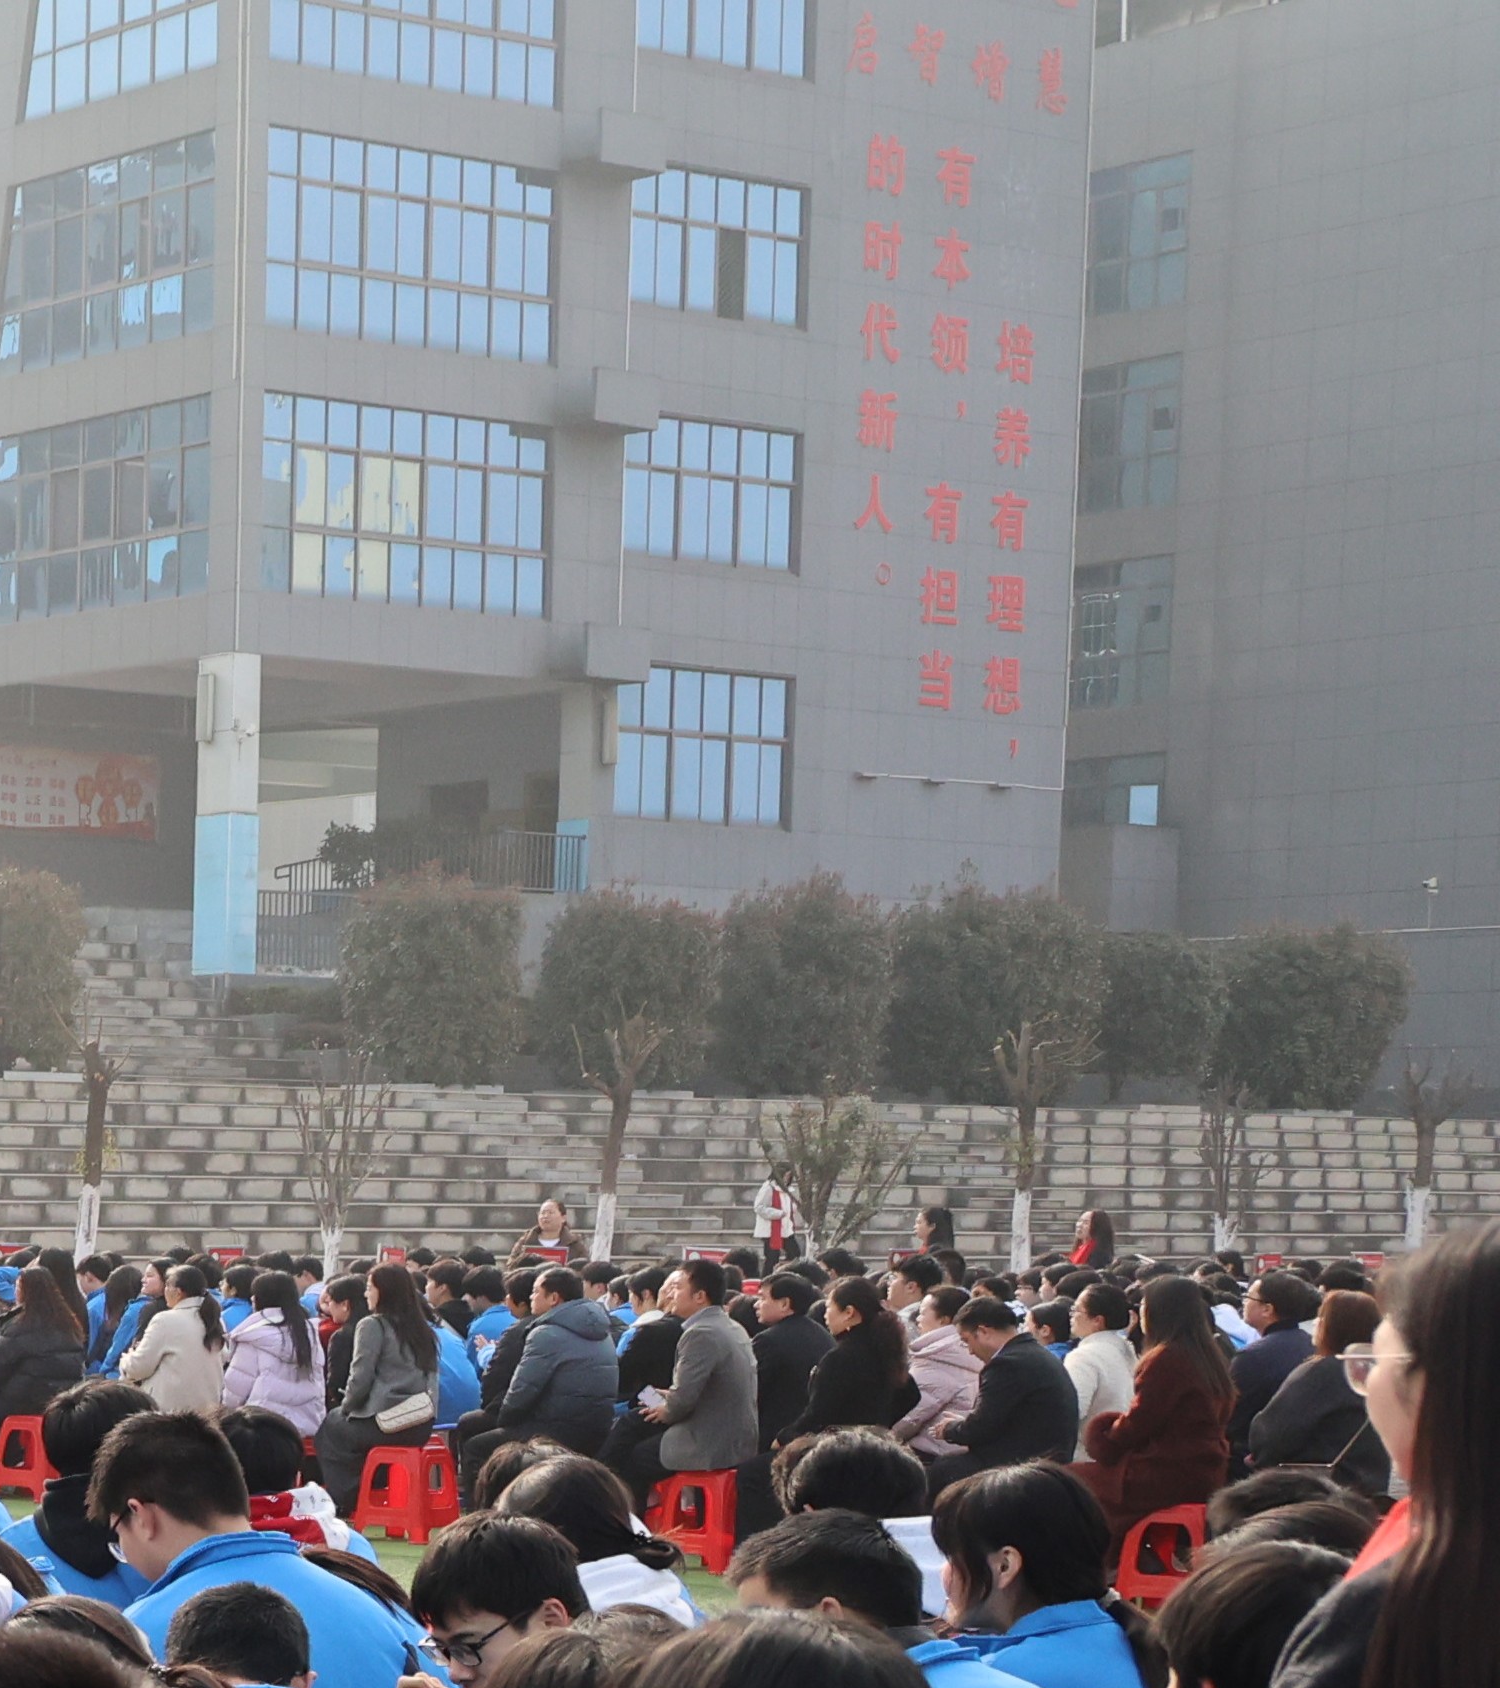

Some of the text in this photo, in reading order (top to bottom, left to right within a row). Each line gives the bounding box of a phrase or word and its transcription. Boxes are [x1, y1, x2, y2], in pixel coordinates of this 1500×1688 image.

[853, 133, 907, 586] 的时代新人。
[917, 146, 978, 712] 有本领，有担当
